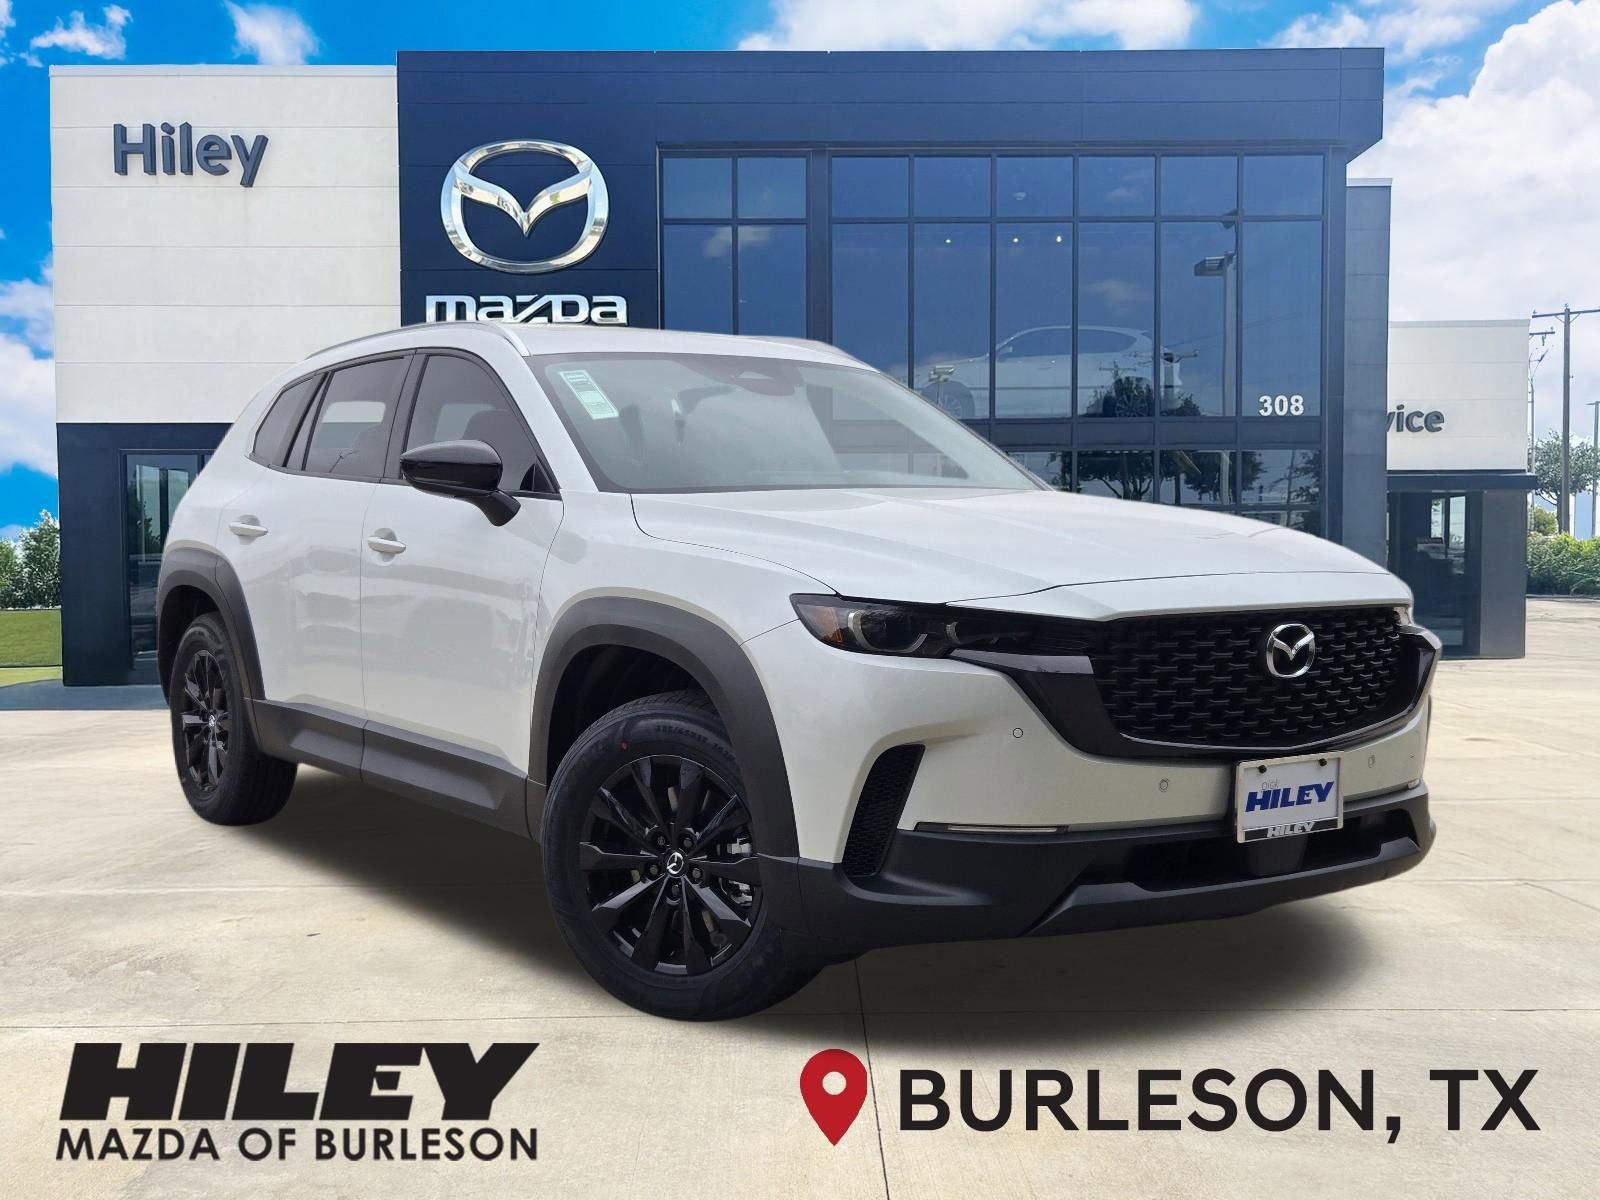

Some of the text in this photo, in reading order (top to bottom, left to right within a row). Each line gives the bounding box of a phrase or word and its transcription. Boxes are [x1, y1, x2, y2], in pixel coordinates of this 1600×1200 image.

[113, 122, 269, 188] Hiley
[1259, 395, 1304, 416] 308
[1245, 781, 1335, 812] HILEY
[1267, 821, 1316, 838] HILEY
